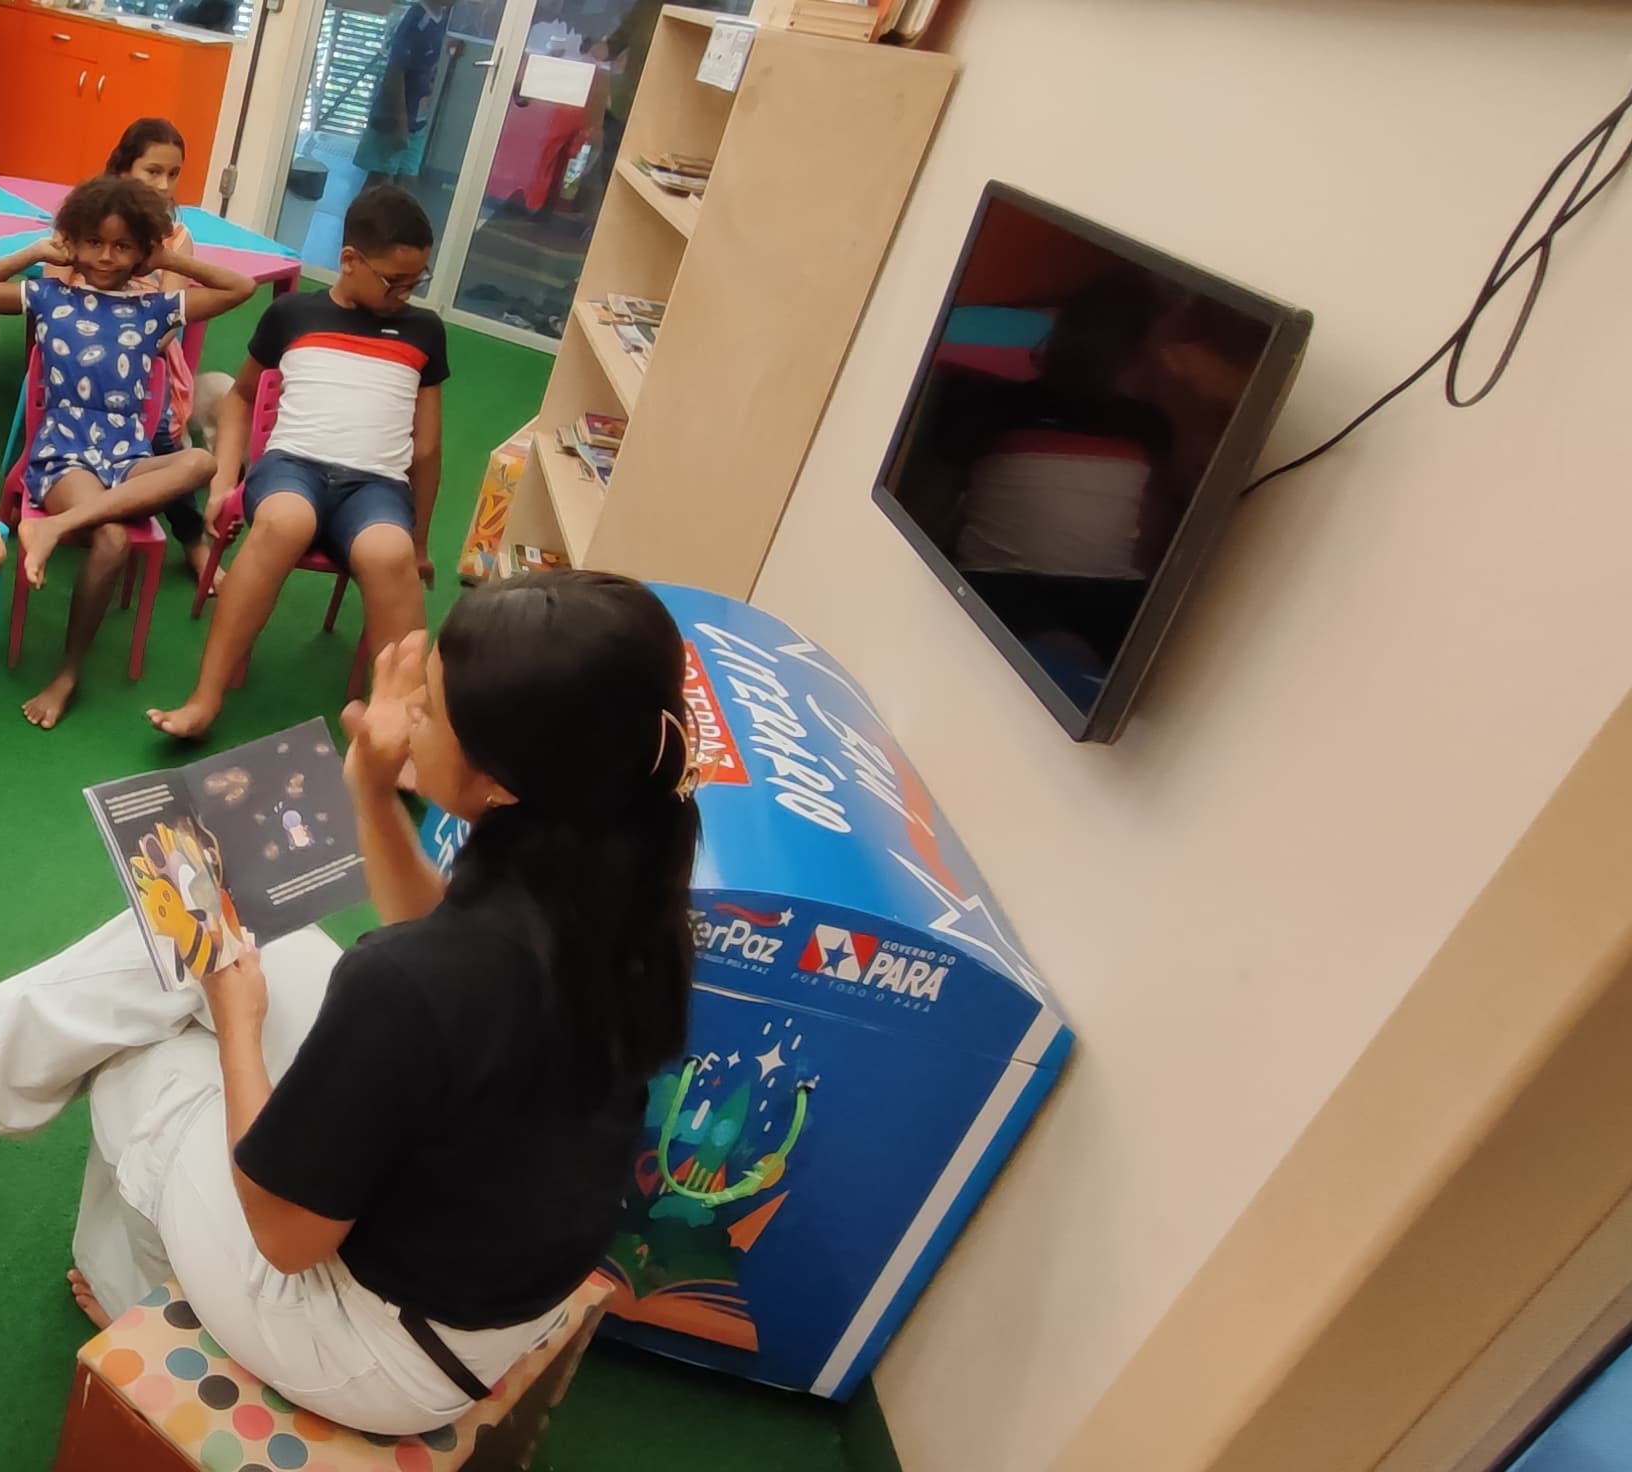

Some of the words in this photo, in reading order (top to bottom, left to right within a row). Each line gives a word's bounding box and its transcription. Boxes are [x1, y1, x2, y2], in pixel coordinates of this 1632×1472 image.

[881, 940, 936, 961] GOVERNO
[939, 953, 956, 966] DO
[790, 972, 818, 986] POR
[828, 980, 867, 998] TODO
[862, 951, 949, 1002] PARÁ
